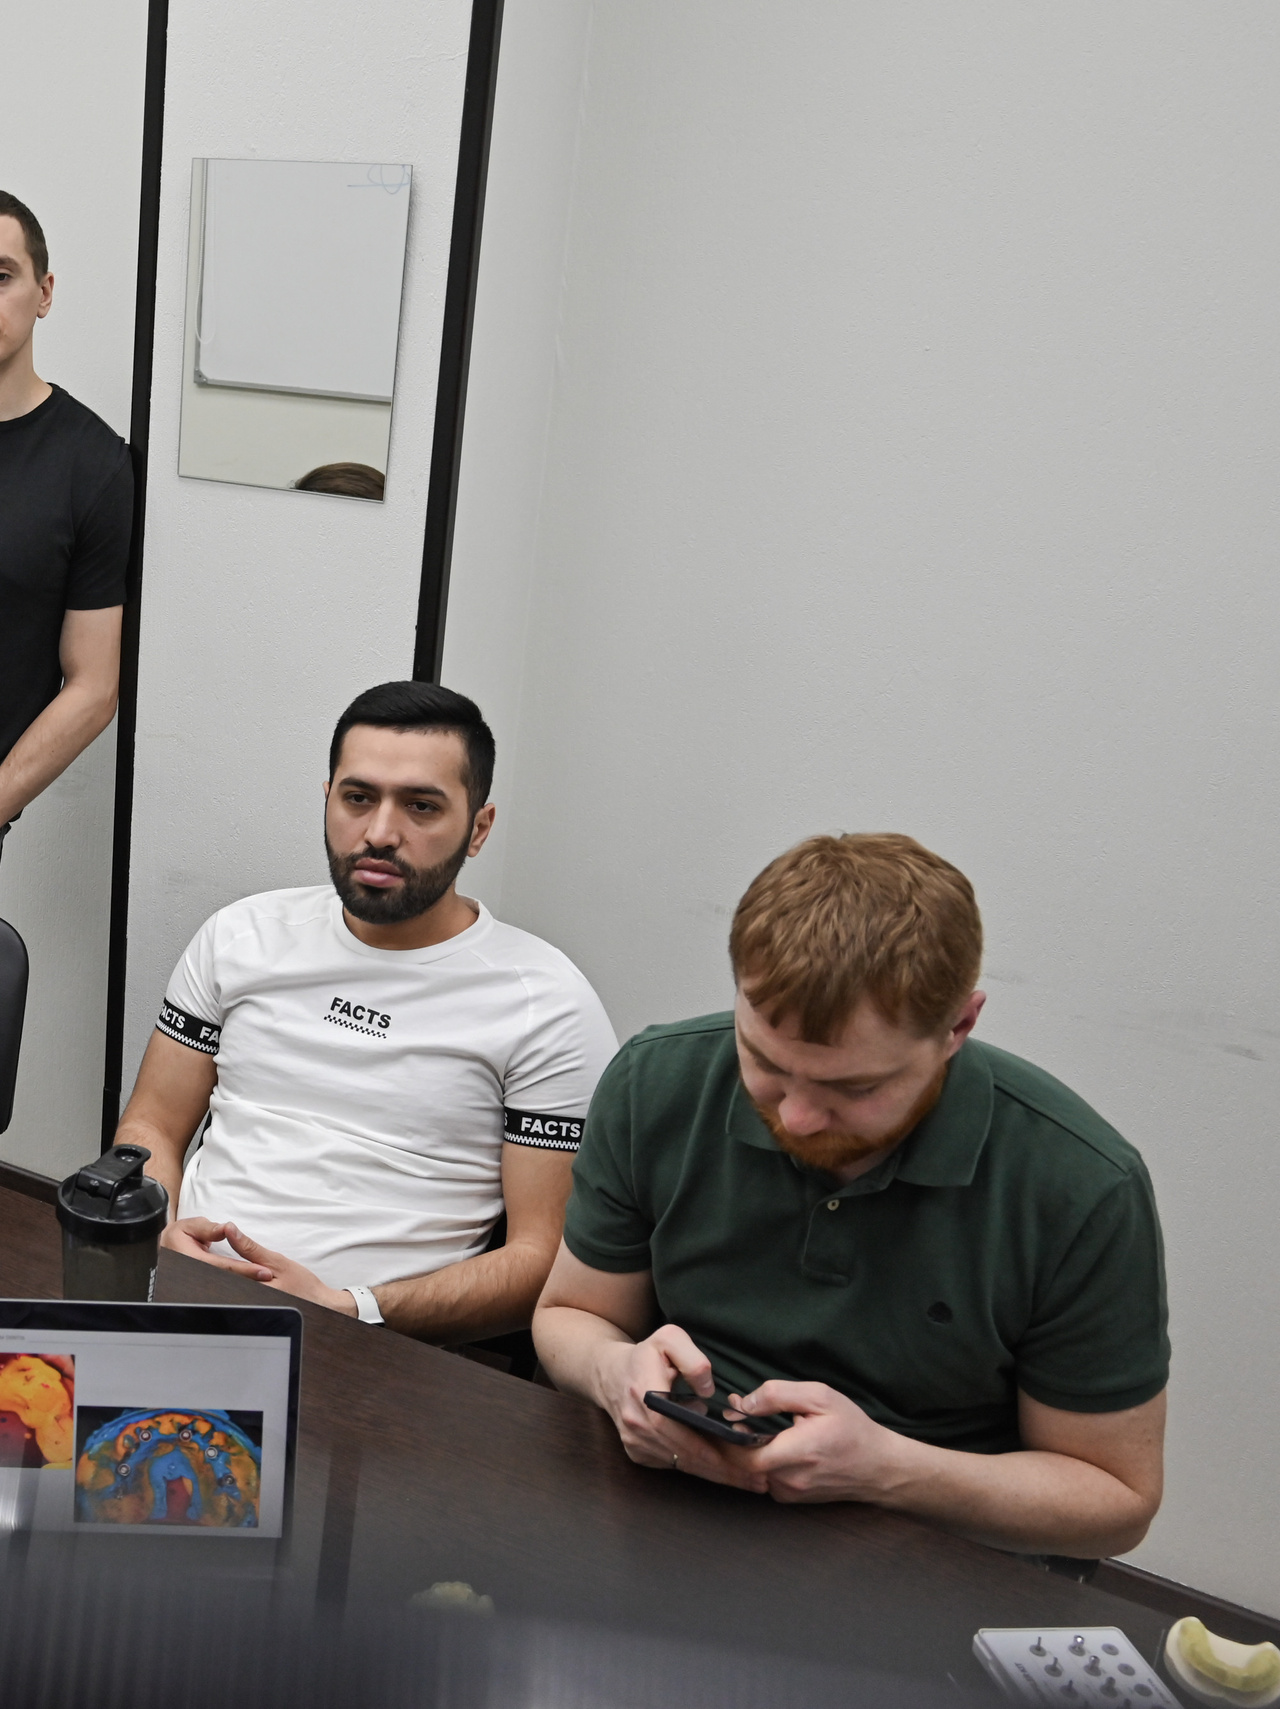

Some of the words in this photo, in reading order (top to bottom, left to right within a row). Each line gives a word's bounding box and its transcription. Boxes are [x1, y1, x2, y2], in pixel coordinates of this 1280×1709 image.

[161, 1005, 186, 1029] ACTS
[199, 1026, 219, 1043] FA
[330, 996, 392, 1029] FACTS
[520, 1116, 581, 1138] FACTS
